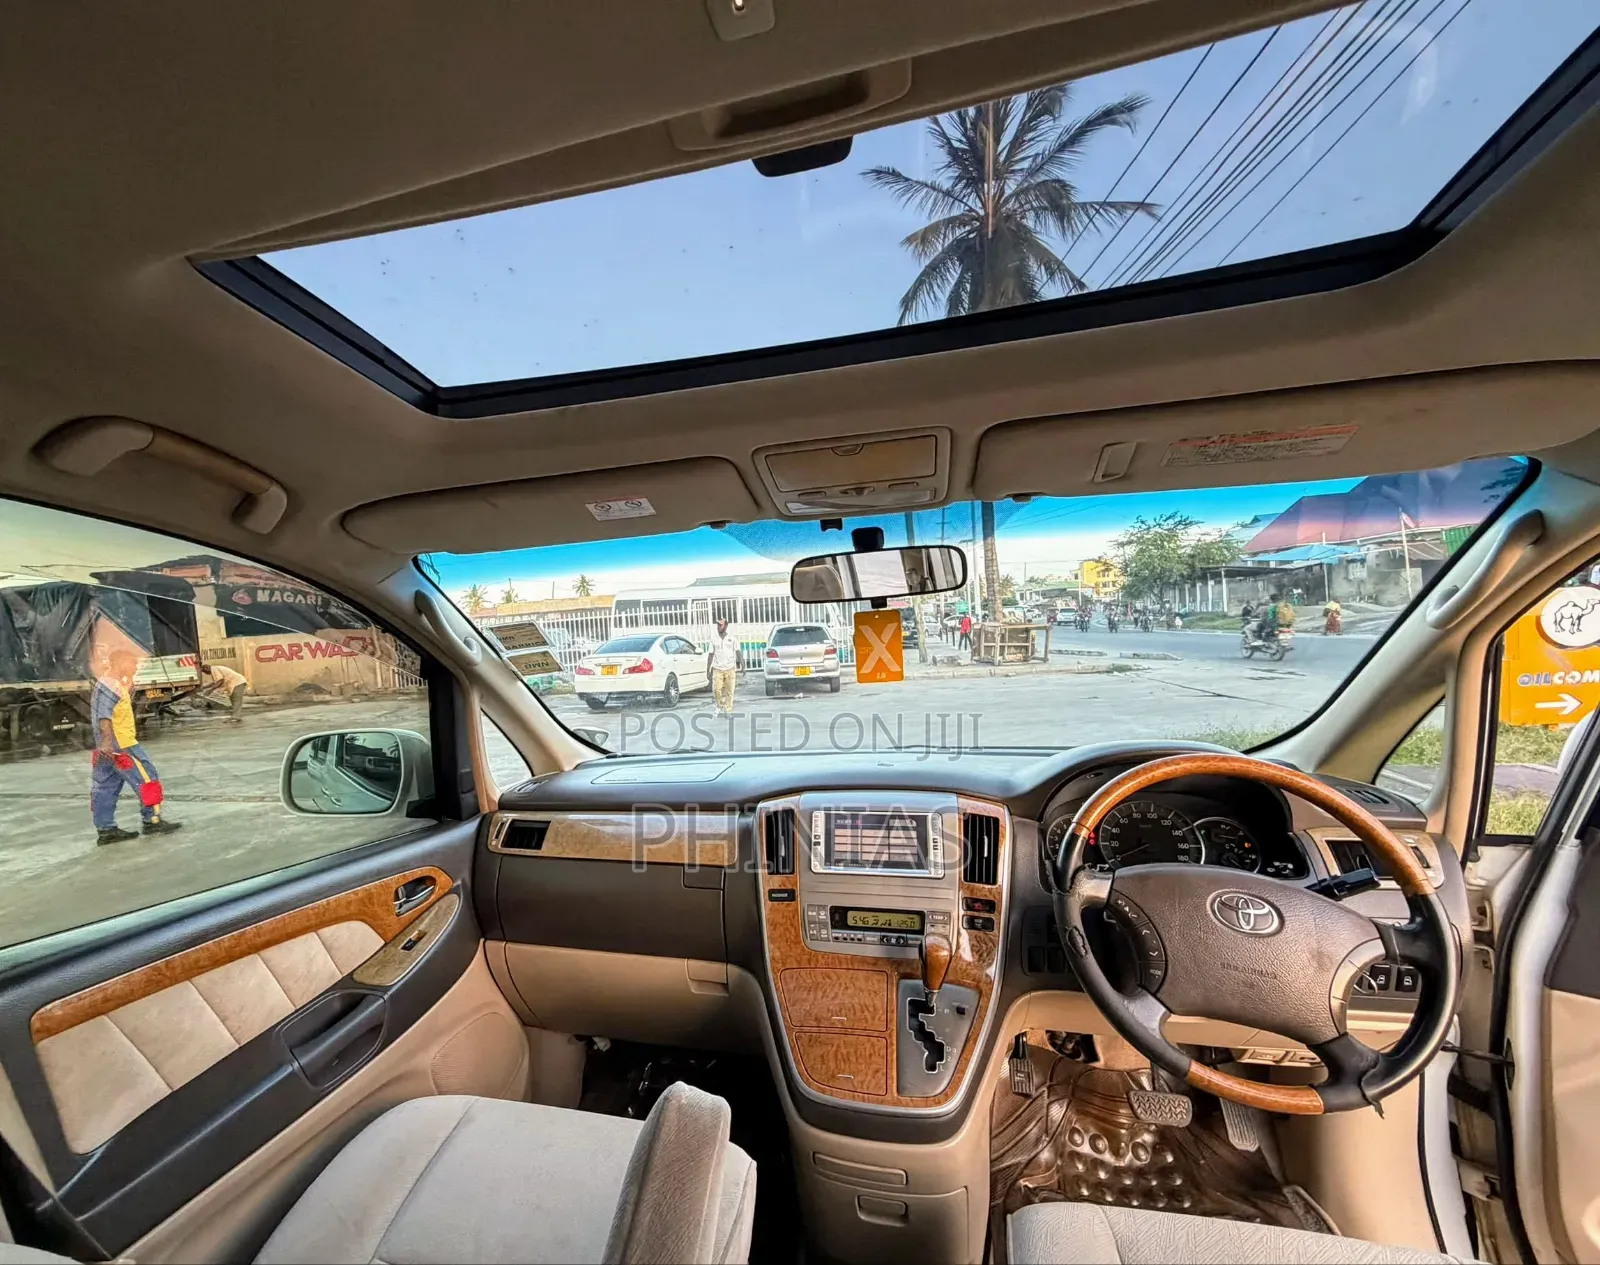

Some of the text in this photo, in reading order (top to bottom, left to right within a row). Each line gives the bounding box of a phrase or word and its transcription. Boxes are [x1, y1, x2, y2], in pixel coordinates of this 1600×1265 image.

[256, 589, 323, 606] MAGARI
[255, 643, 303, 663] CAR
[1517, 669, 1600, 687] OILCOM
